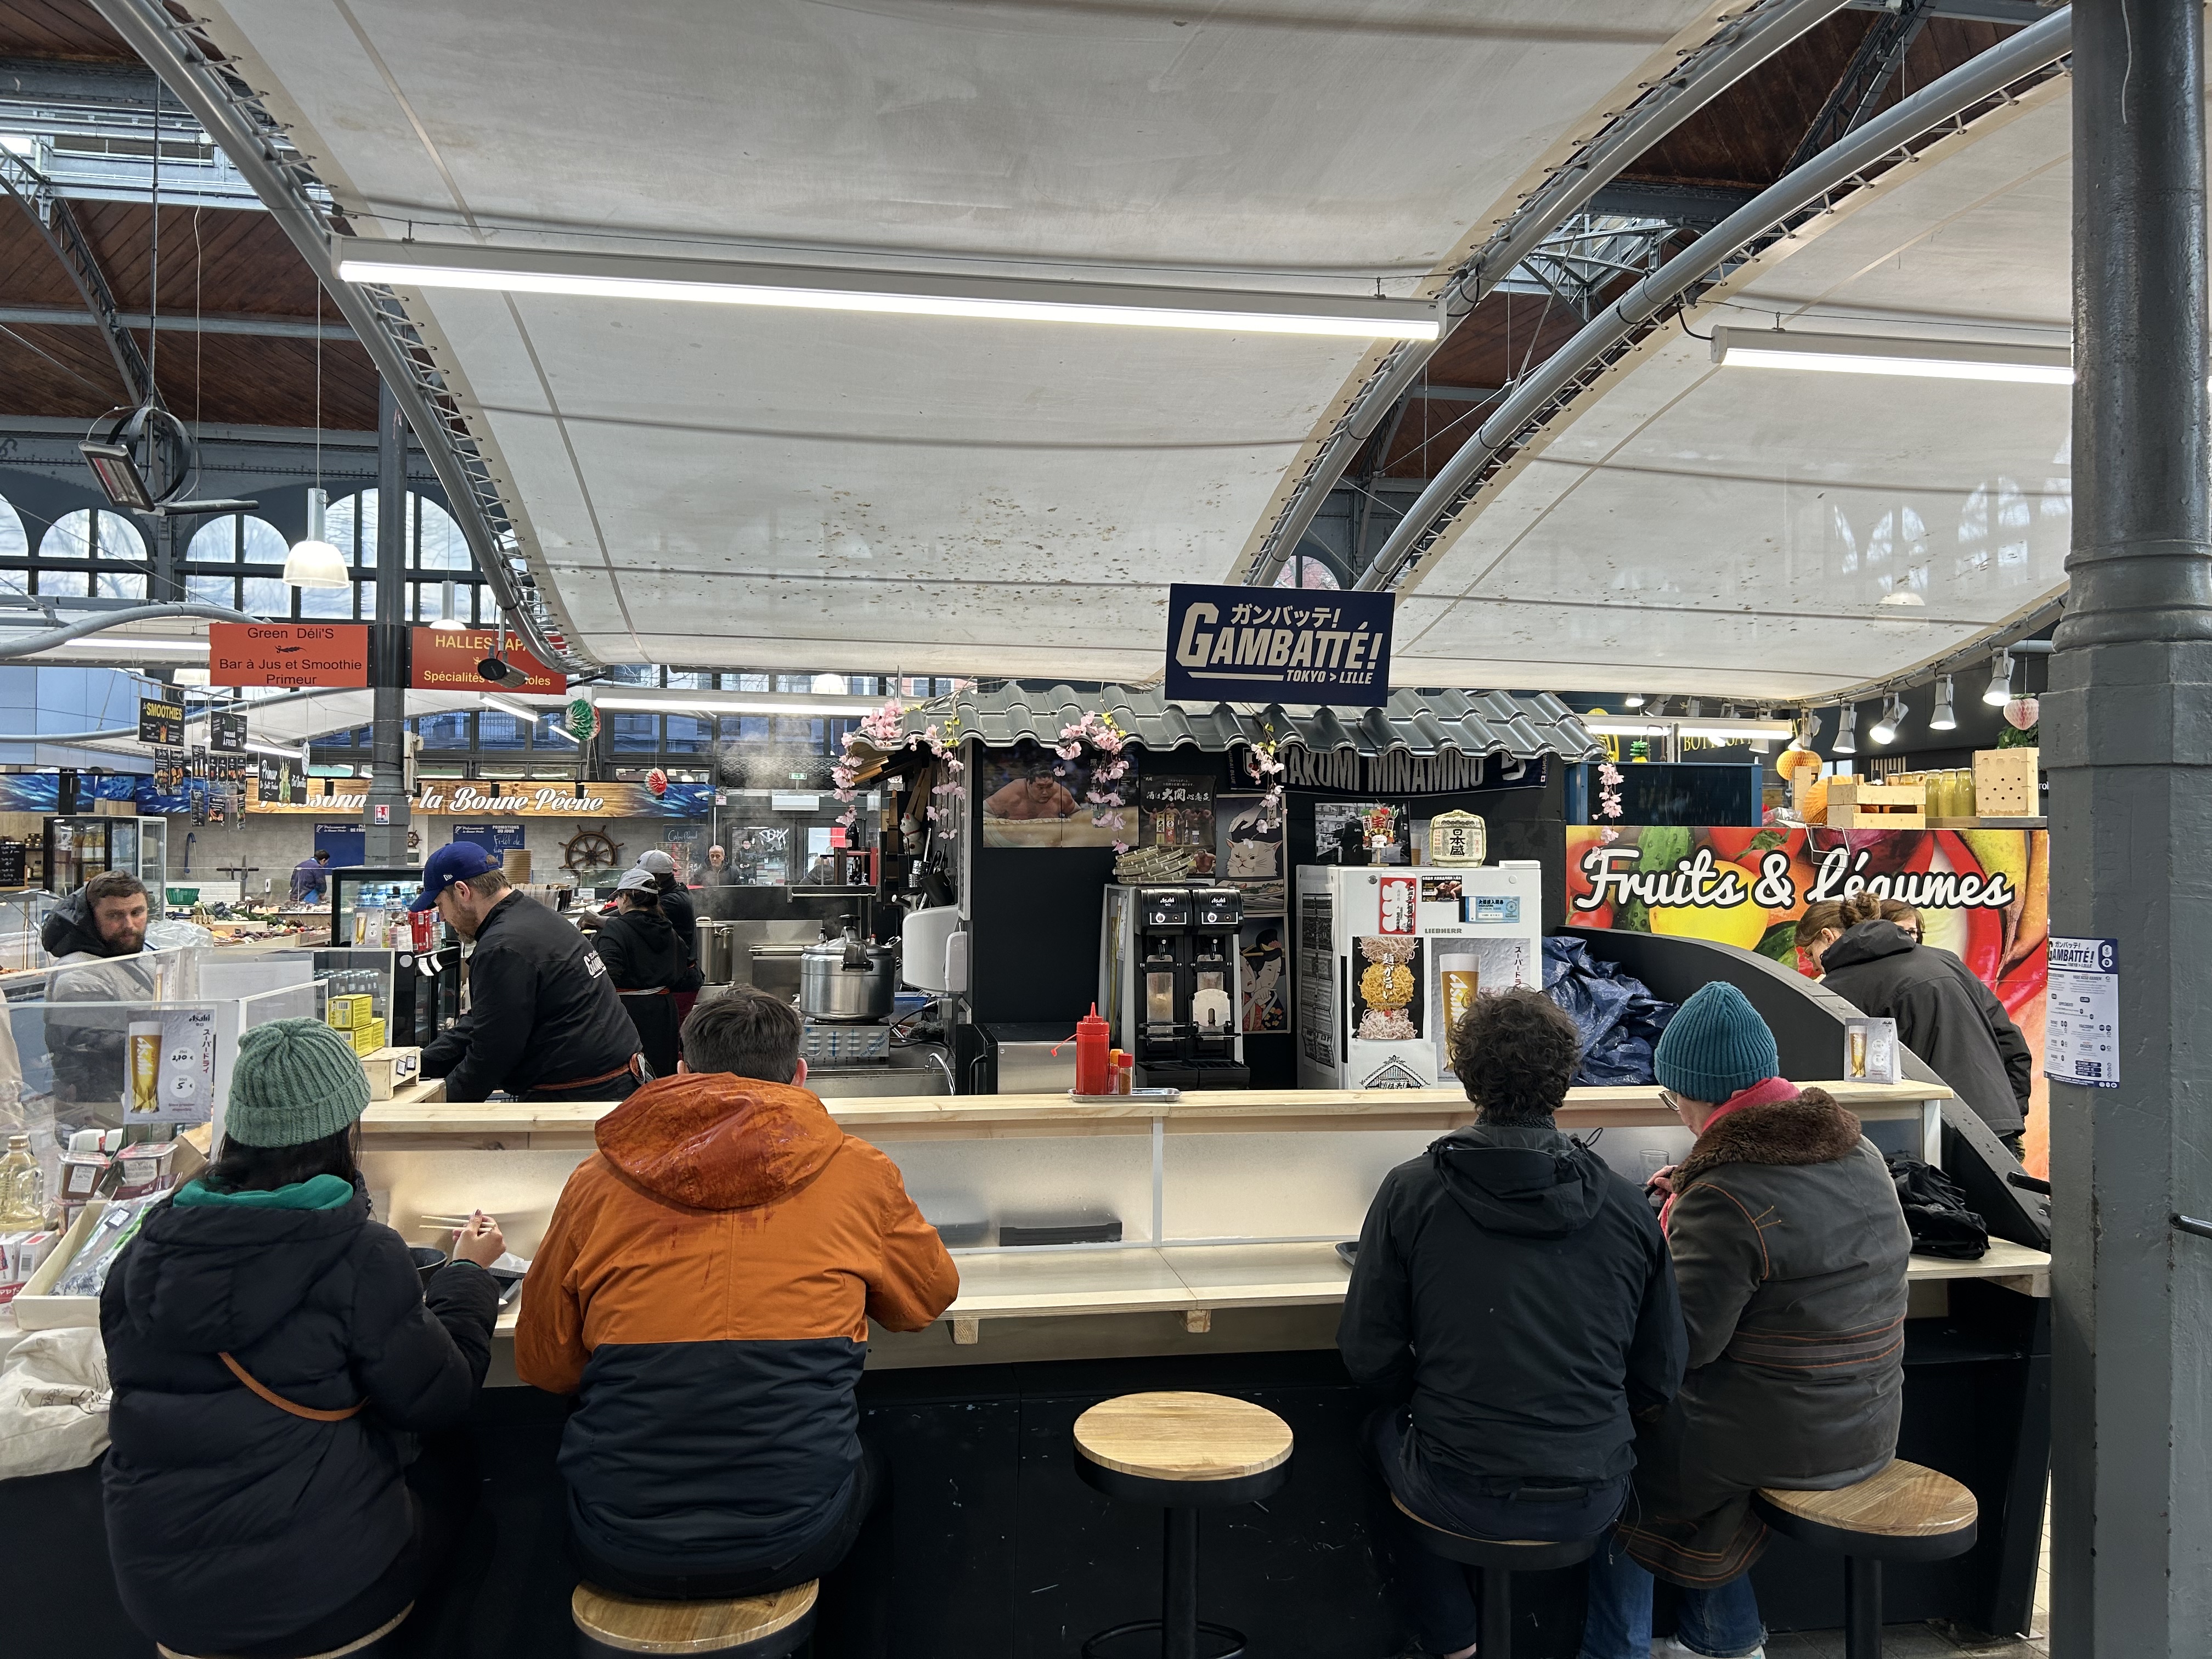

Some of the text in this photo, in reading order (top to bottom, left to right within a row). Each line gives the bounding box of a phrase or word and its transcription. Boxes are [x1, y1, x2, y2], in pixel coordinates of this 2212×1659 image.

[1231, 603, 1341, 629] ガンバッテ!
[247, 627, 334, 639] Green Déli'S
[1175, 602, 1384, 670] GAMBATTÉ!
[435, 634, 493, 651] HALLES
[219, 658, 362, 671] Bar à Jus et Smoothie
[266, 674, 318, 685] Primeur
[424, 670, 485, 684] Spécialités
[1286, 669, 1327, 683] TOKYO
[1339, 671, 1373, 685] LILLE
[146, 702, 183, 721] SMOOTHIES
[224, 717, 236, 731] JUS
[419, 786, 443, 809] la
[449, 787, 530, 812] Bonne
[533, 788, 605, 811] Pêche
[1576, 847, 1746, 908] Fruits
[1754, 853, 1795, 906] &
[1514, 946, 1523, 989] スーパードラ
[189, 1014, 211, 1022] Asahi
[201, 1029, 212, 1074] スーパードライ
